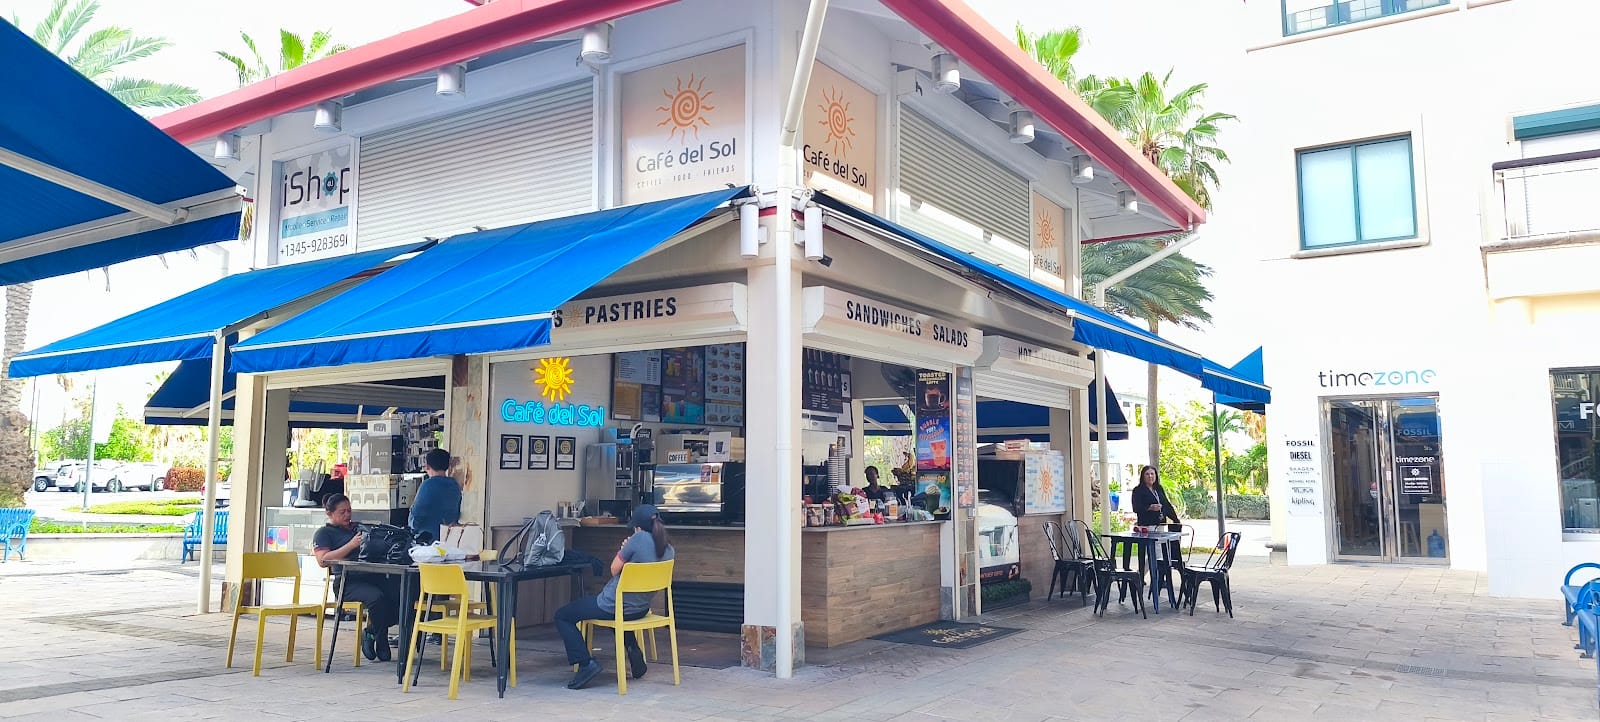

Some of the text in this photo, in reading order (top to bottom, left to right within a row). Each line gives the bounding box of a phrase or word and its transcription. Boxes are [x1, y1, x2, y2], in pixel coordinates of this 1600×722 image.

[636, 138, 736, 173] Café del Sol
[803, 144, 830, 171] Café
[833, 160, 849, 180] del
[852, 167, 868, 189] Sol
[585, 296, 677, 325] PASTRIES
[846, 300, 969, 348] SANDWICHES SALADS
[1318, 369, 1436, 388] timezone
[501, 399, 605, 427] Café del Sol
[1580, 402, 1600, 420] F
[1397, 428, 1432, 437] FOSSIL
[669, 453, 688, 462] COFFEE
[1289, 451, 1312, 460] DIESEL
[1395, 456, 1435, 464] timezone
